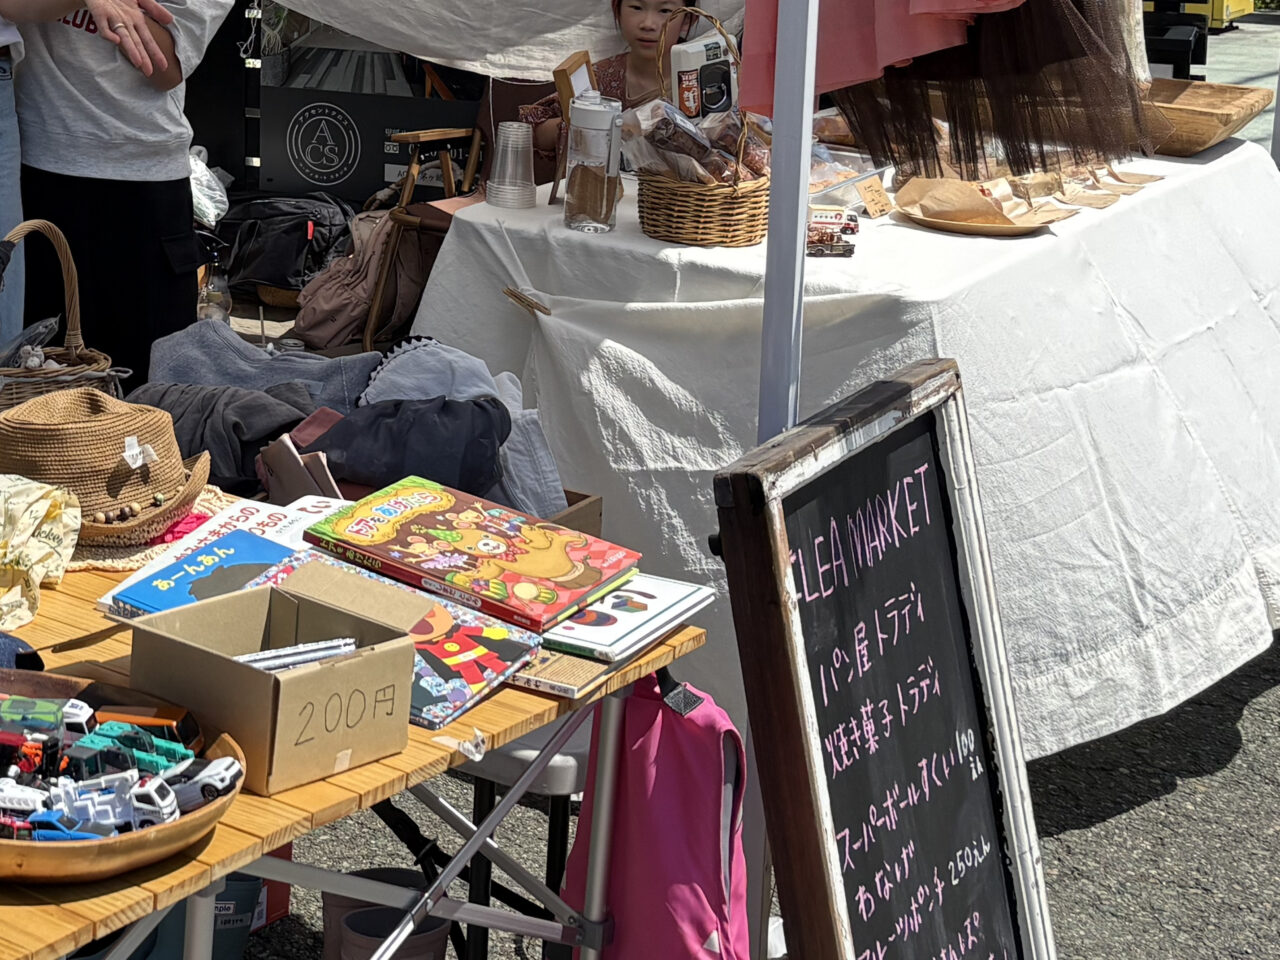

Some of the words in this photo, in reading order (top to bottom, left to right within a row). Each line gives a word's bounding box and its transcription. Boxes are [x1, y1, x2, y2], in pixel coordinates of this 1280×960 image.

[789, 516, 849, 602] LEA
[847, 462, 931, 580] MARKET
[151, 546, 236, 592] あーんあん
[294, 683, 396, 747] 200円
[855, 840, 915, 922] わなげ
